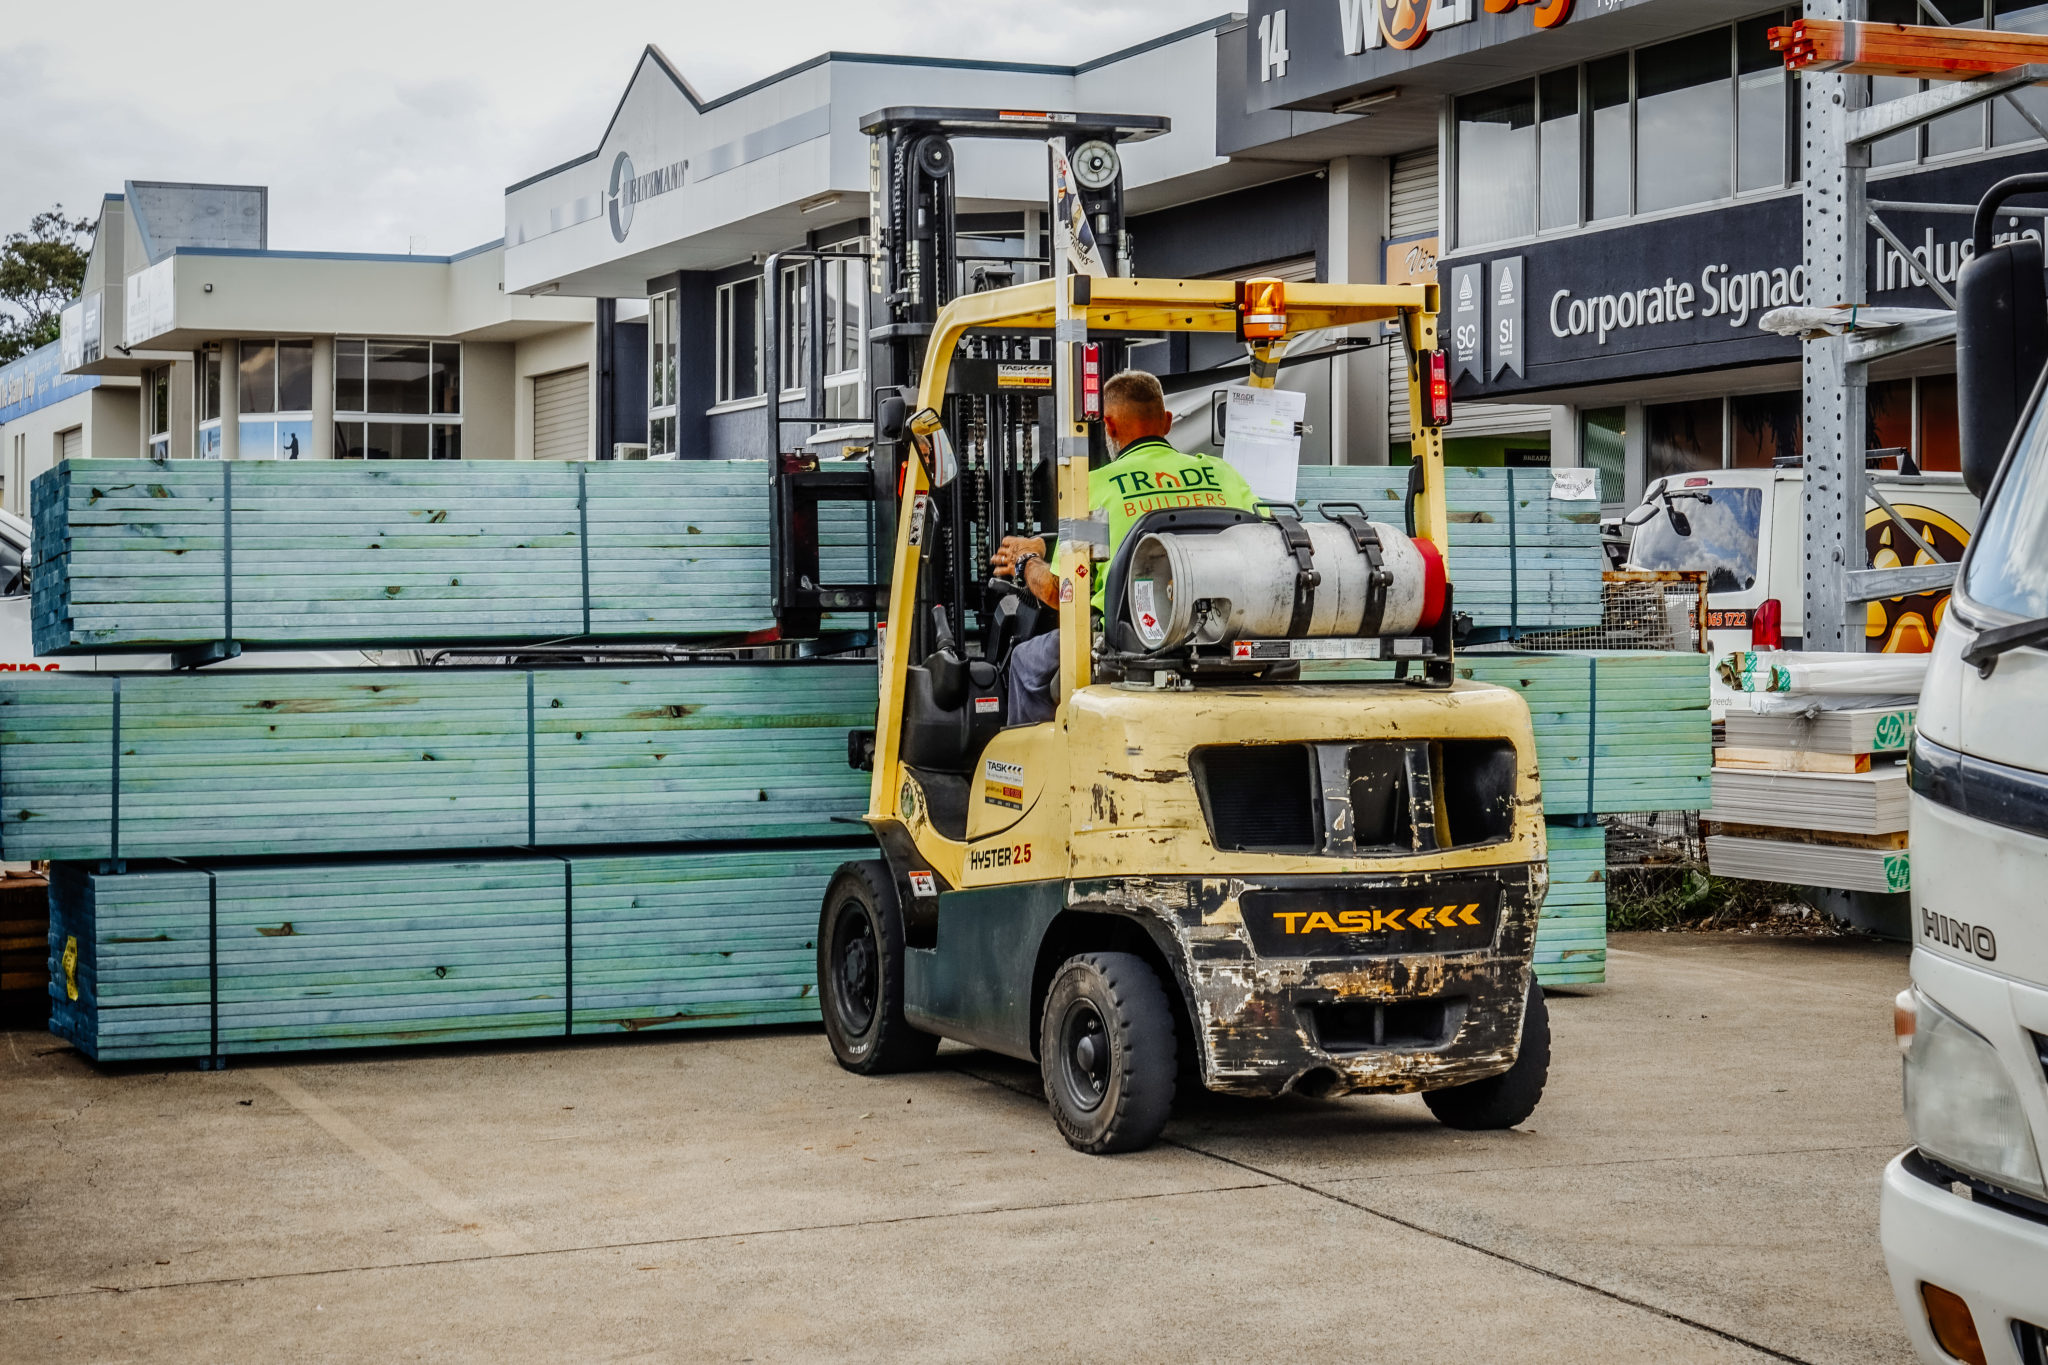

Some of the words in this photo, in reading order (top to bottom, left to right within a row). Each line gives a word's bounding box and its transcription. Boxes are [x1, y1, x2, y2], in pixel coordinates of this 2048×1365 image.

[1258, 9, 1290, 82] 14
[870, 142, 882, 294] HYSTER
[1550, 278, 1695, 344] Corporate
[1456, 324, 1476, 350] SC
[1499, 318, 1513, 344] SI
[1109, 466, 1220, 495] TRADE
[1123, 493, 1227, 518] BUILDERS
[1724, 612, 1747, 627] 1722
[1712, 697, 1733, 707] needs
[987, 760, 1007, 773] TASK
[971, 847, 1011, 870] HYSTER
[1013, 843, 1032, 865] 2.5
[1273, 908, 1406, 935] TASK
[1922, 907, 1997, 962] HINO
